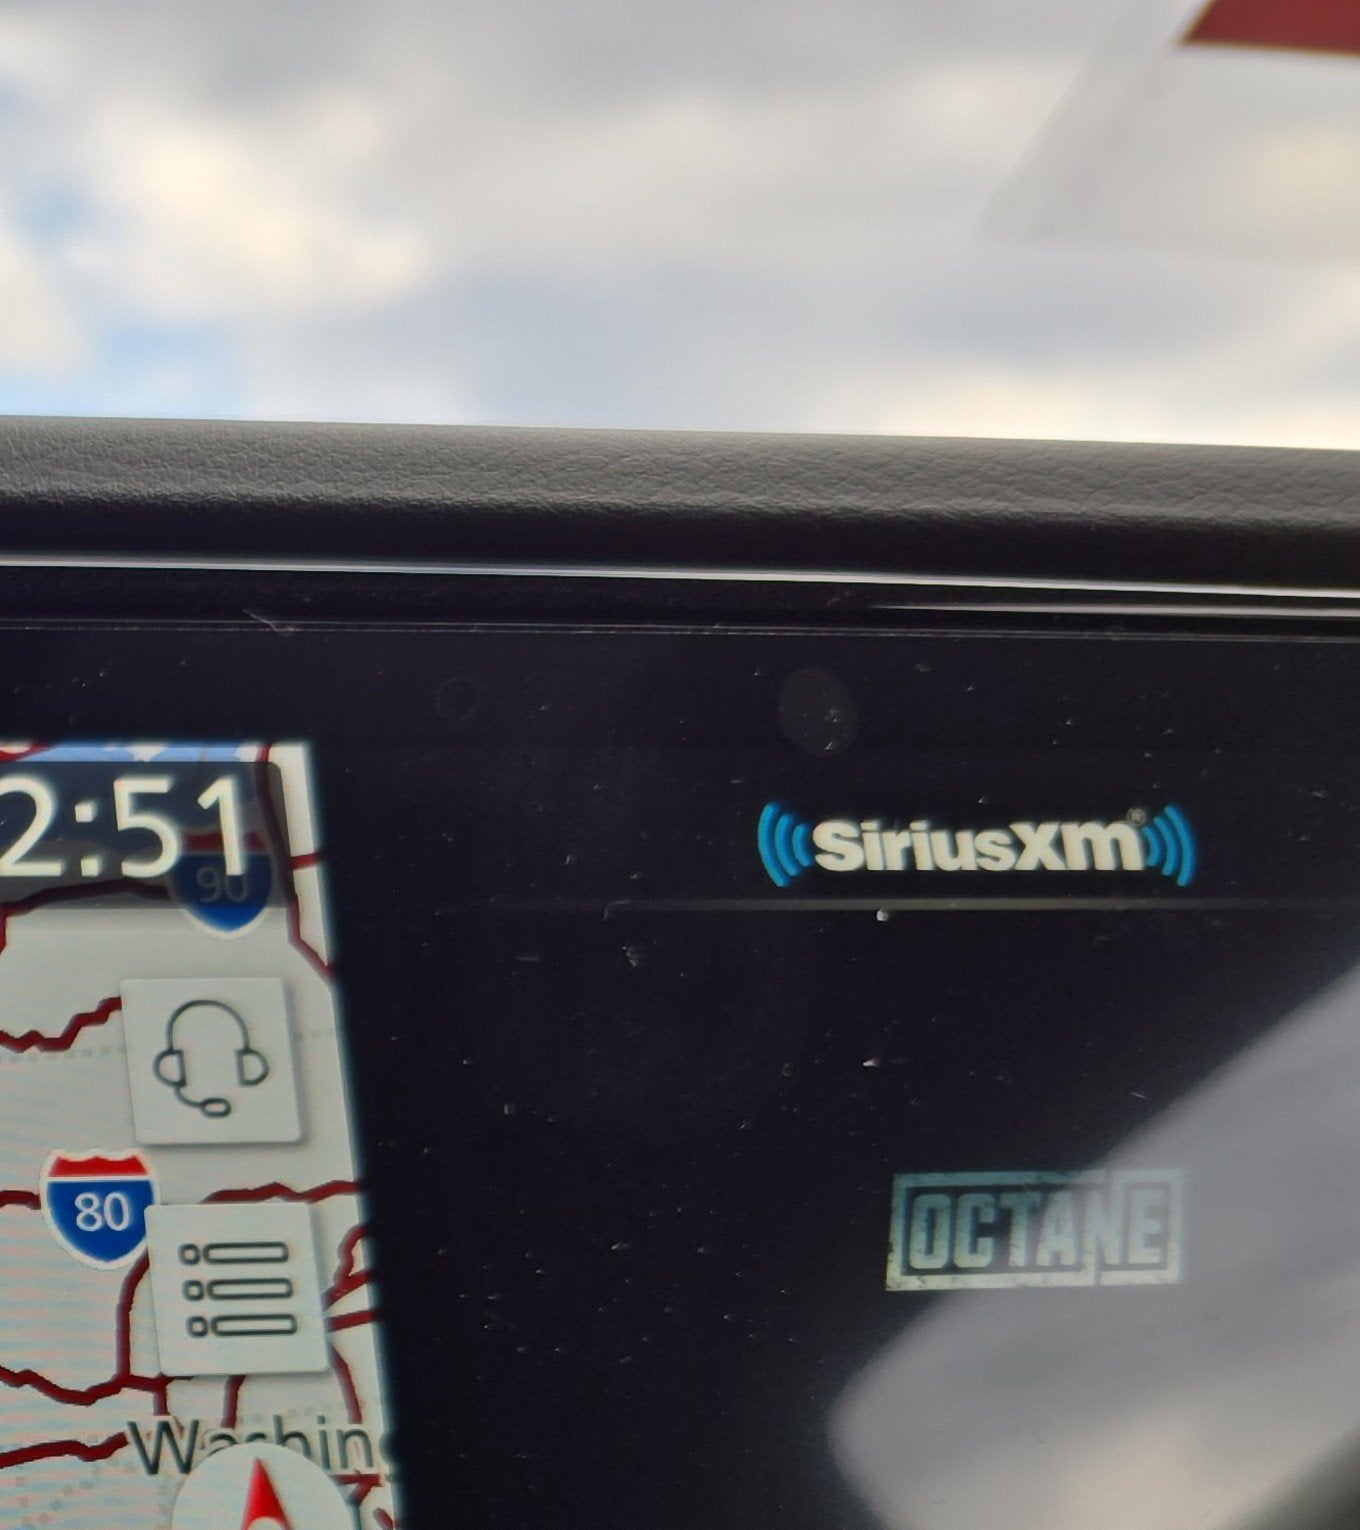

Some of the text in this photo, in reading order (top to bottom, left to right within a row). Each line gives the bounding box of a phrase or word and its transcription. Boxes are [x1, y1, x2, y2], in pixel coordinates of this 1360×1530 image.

[195, 865, 250, 904] 90
[73, 1191, 130, 1232] 80
[908, 1189, 1167, 1270] OCTANE
